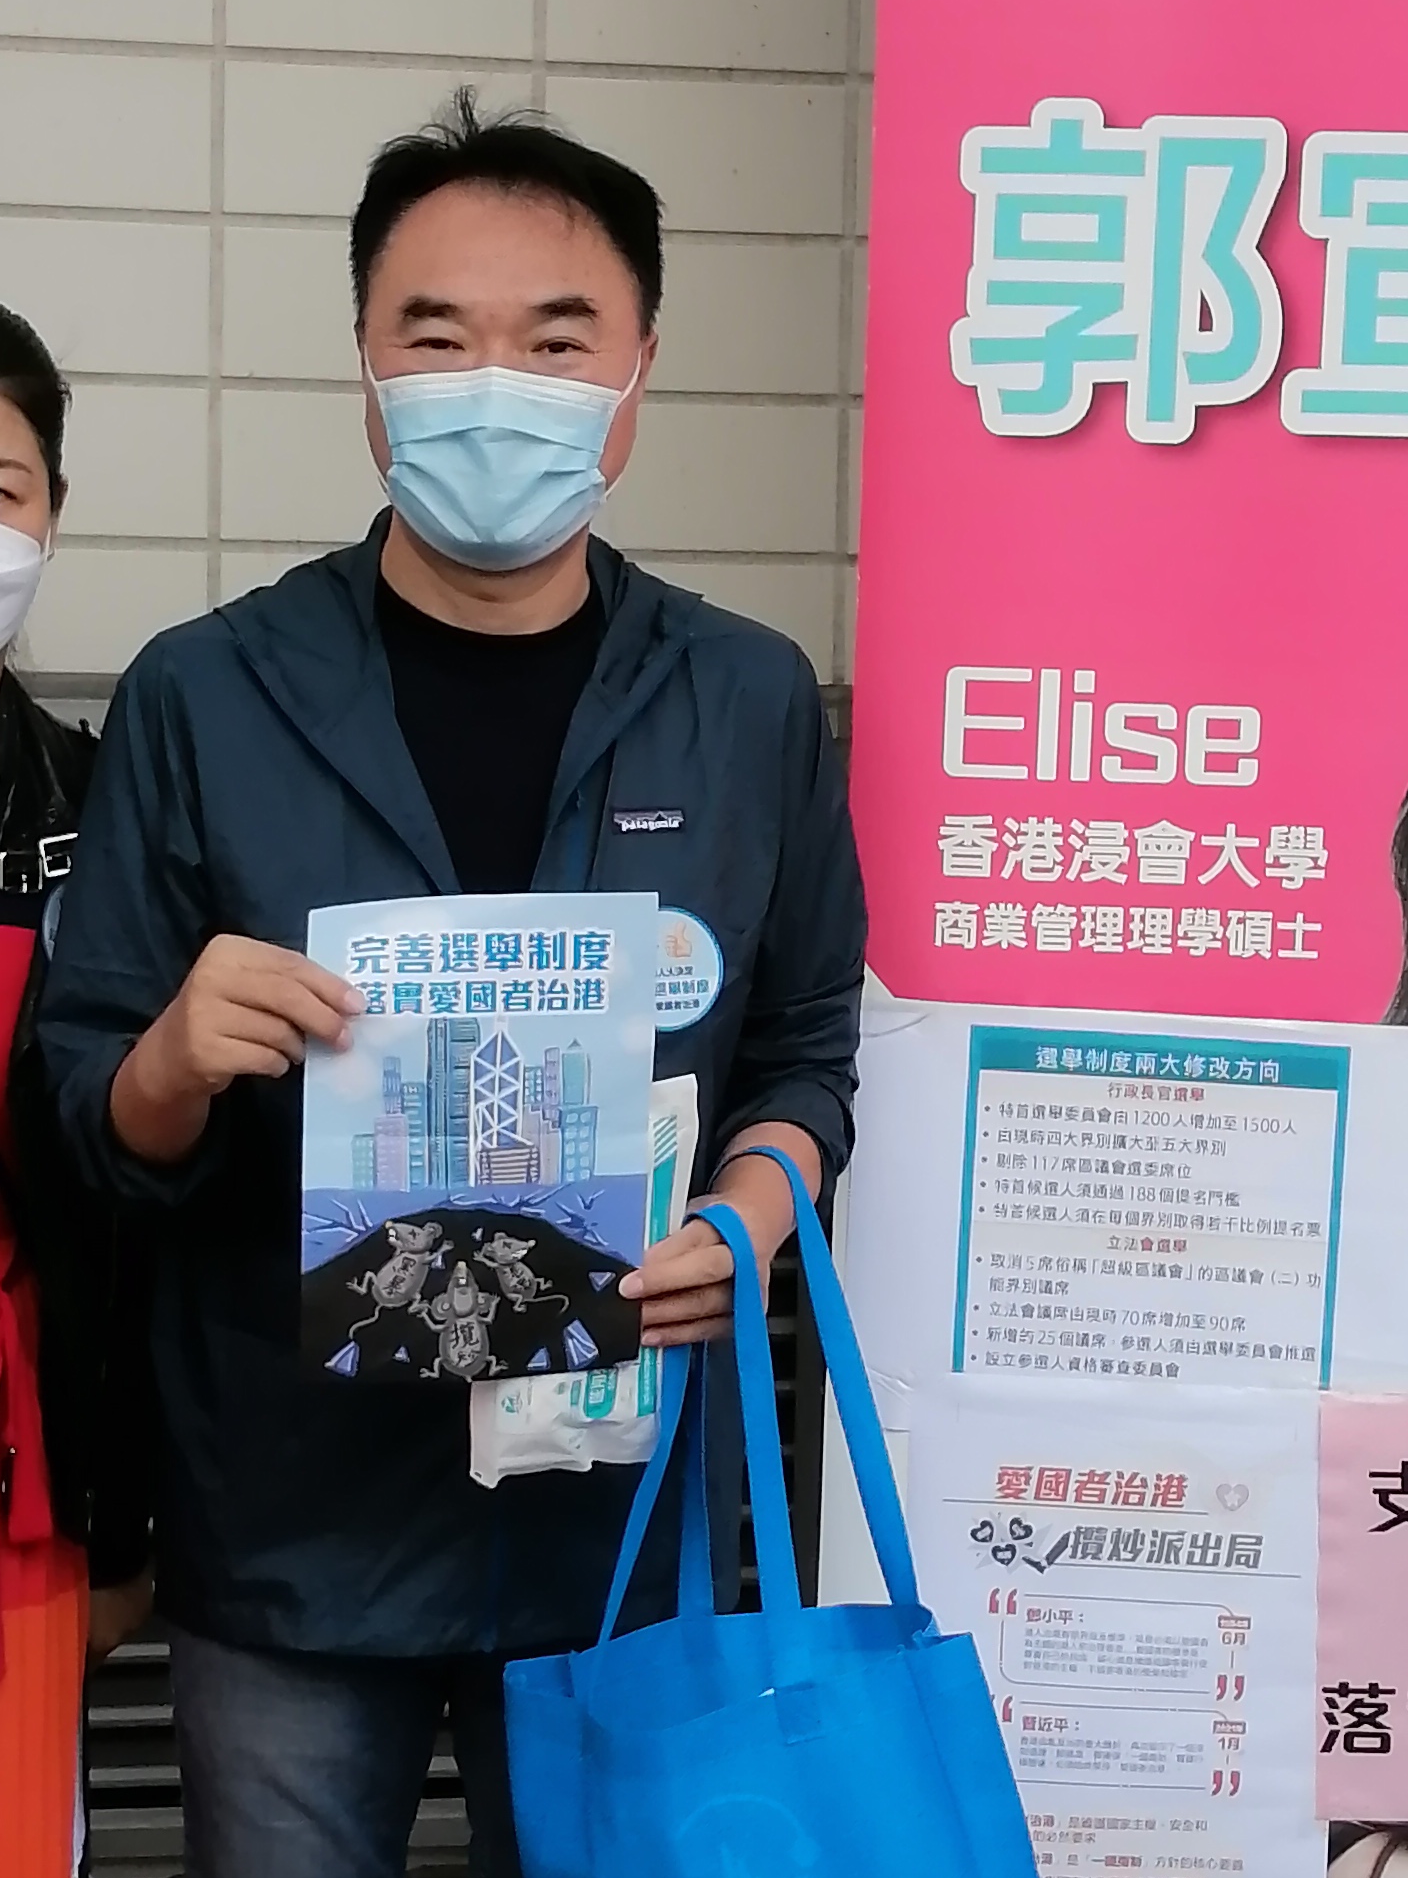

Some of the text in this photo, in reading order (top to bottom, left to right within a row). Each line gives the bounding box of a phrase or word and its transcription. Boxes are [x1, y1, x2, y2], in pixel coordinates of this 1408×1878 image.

[941, 667, 1260, 787] Elise
[937, 817, 1327, 890] 香港浸會大學
[349, 930, 612, 973] 完善選舉制度
[932, 902, 1321, 961] 商業管理理學碩士
[357, 977, 606, 1015] 落實愛國者治港
[1035, 1045, 1280, 1083] 選舉制度兩大修改方向
[1108, 1083, 1205, 1103] 行政長官選舉
[1107, 1234, 1187, 1253] 立法會選舉
[995, 1465, 1189, 1509] 愛國者治港
